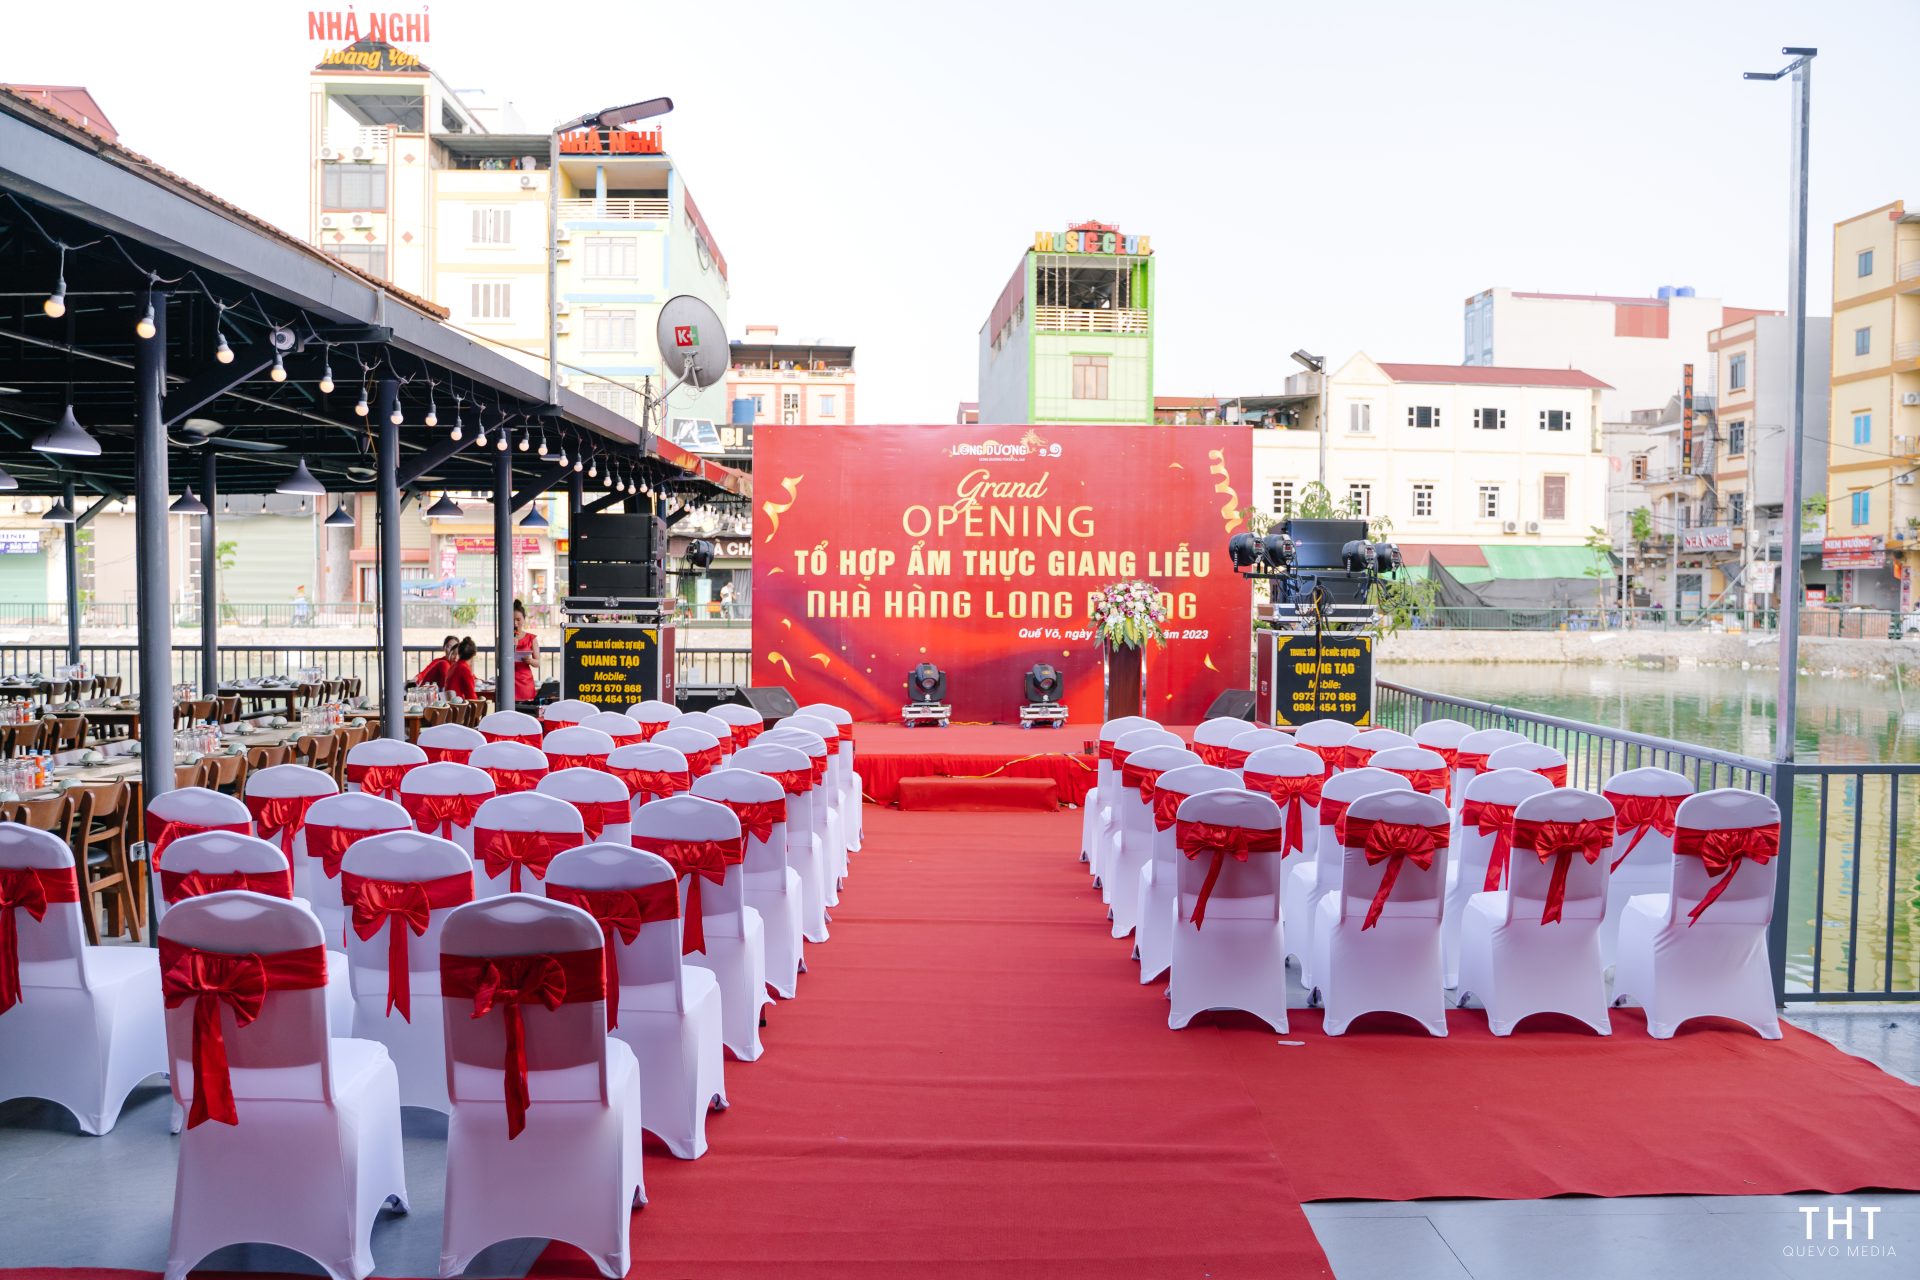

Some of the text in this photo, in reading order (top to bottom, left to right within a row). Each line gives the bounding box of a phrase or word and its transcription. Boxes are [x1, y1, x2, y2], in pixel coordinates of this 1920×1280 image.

[308, 5, 430, 42] NHÀ NGHỈ
[322, 46, 381, 69] Hoàng
[608, 125, 662, 153] NGHỈ
[1034, 231, 1151, 255] MUSIC CLUB
[952, 443, 1027, 456] LONG DƯƠNG
[956, 468, 1050, 514] Grand
[902, 504, 1096, 537] OPENING
[794, 540, 1210, 582] TỔ HỢP ẨM THỰC GIANG LIỄU
[808, 583, 871, 618] NHÀ
[884, 583, 971, 618] HÀNG
[985, 591, 1073, 618] LONG
[1018, 627, 1042, 639] Quế
[1044, 628, 1062, 640] Võ,
[1065, 628, 1093, 641] ngày
[1182, 630, 1209, 640] 2023
[581, 655, 640, 669] QUANG TẠO
[594, 671, 627, 681] Mobile:
[1334, 663, 1355, 676] TẠO
[578, 683, 642, 693] 0973 670 868
[579, 694, 642, 703] 0984 454 191
[1338, 692, 1357, 701] 868
[1339, 703, 1356, 712] 191
